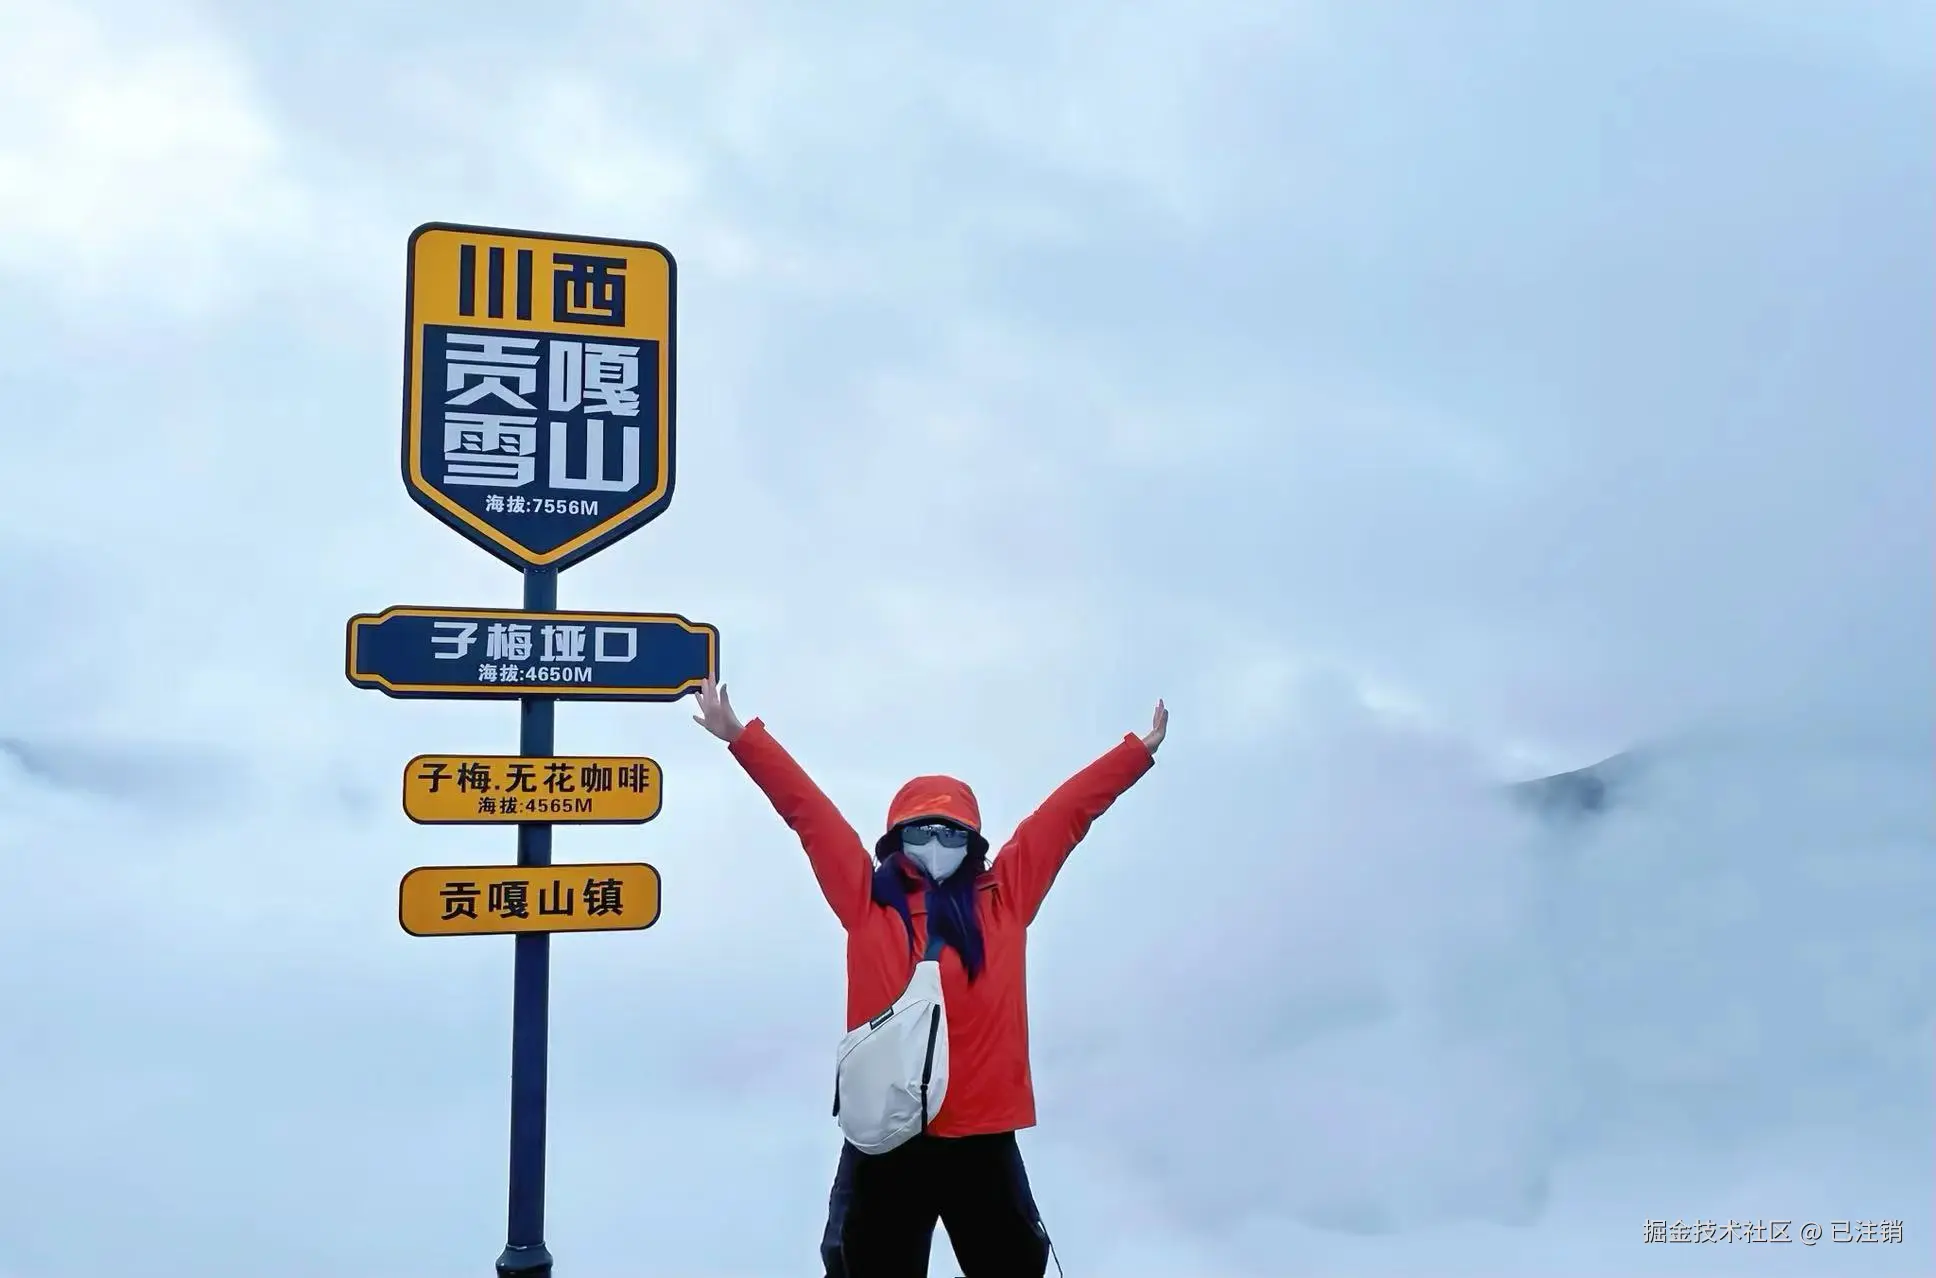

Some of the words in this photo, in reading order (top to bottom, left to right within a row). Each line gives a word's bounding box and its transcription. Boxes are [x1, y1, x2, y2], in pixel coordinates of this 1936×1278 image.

[459, 244, 628, 327] 川西
[444, 332, 640, 417] 贡嘎
[443, 412, 640, 492] 雪山
[485, 494, 599, 516] 海拔:7556M
[431, 620, 638, 663] 子梅垭口
[478, 663, 593, 684] 海拔:4650M
[477, 796, 593, 816] 海拔:4565M
[439, 878, 624, 920] 贡嘎山镇
